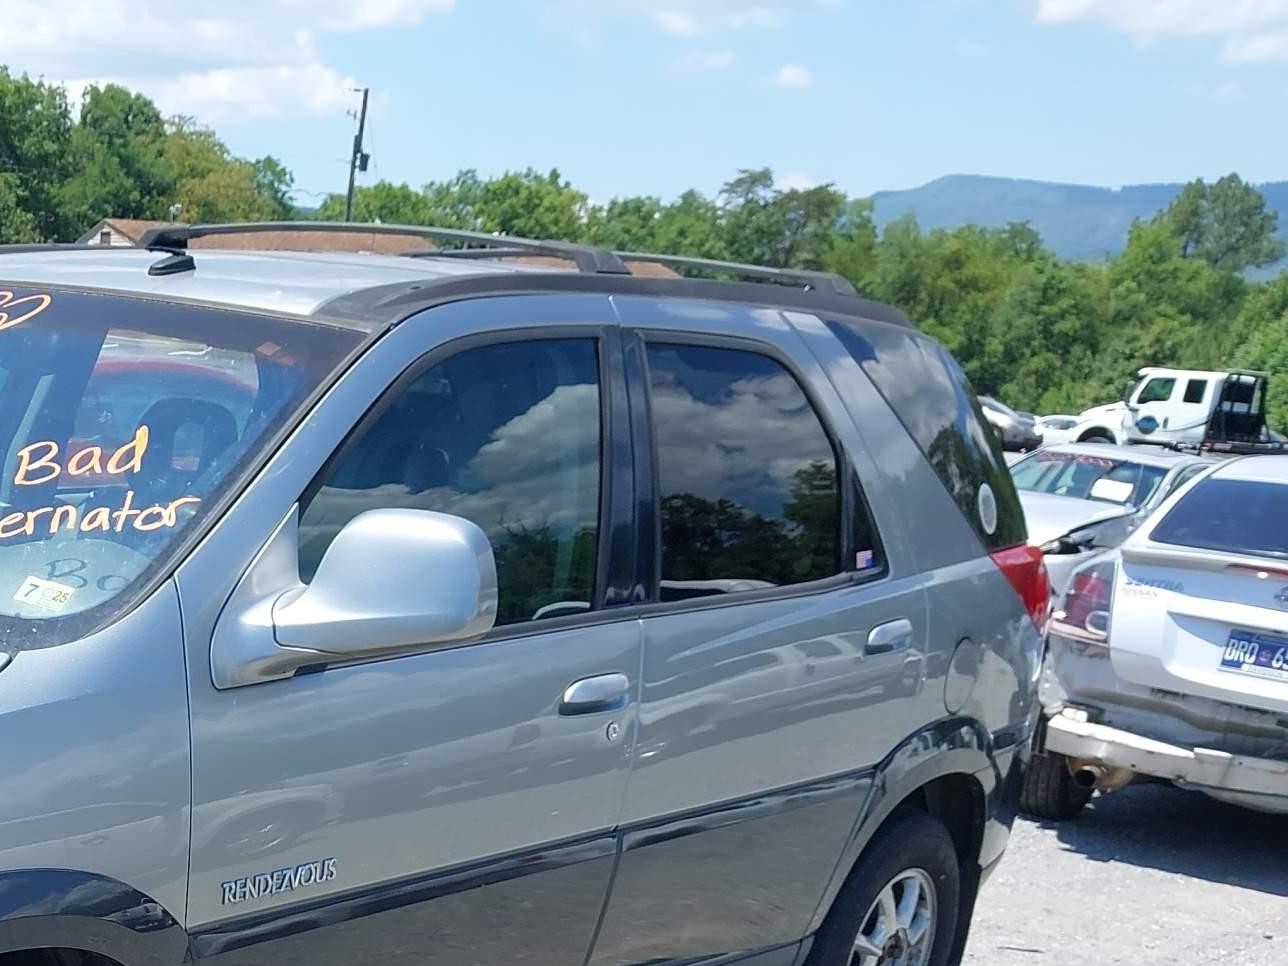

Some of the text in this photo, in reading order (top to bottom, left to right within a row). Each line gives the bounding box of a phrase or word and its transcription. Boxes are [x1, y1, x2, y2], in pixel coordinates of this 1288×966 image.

[14, 424, 149, 486] Bad
[23, 583, 70, 604] 7 25
[221, 857, 338, 905] RENDEZVOUS
